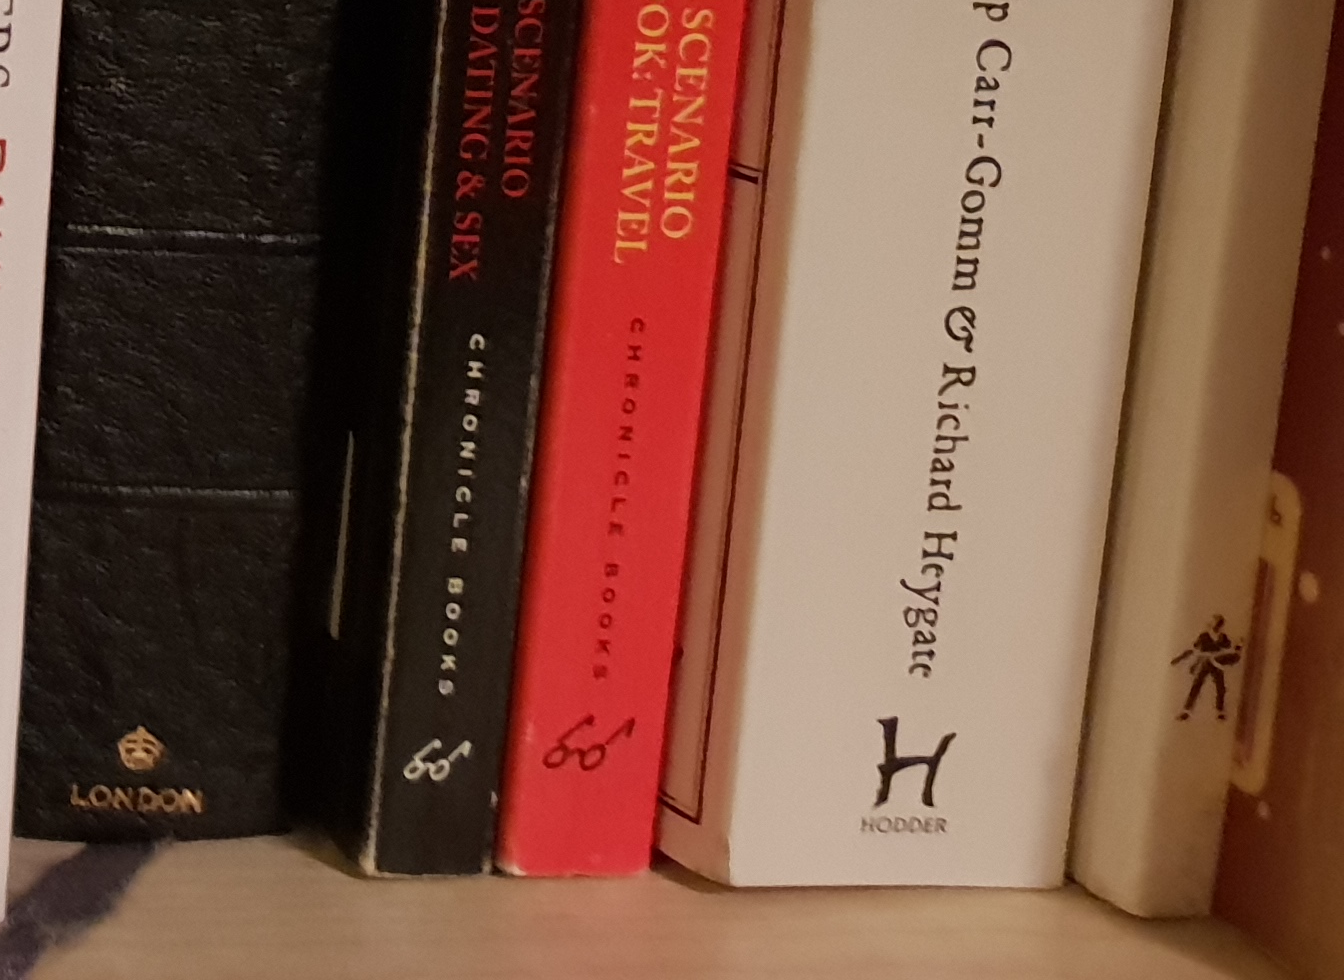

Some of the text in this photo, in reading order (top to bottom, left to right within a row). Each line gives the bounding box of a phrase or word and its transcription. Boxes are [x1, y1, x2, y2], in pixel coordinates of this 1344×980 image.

[457, 5, 504, 162] DATING
[657, 6, 715, 240] SCENARIO
[453, 168, 485, 202] &
[611, 89, 664, 266] TRAVEL
[948, 38, 1014, 294] Carr-Gomm
[445, 209, 484, 285] SEX
[944, 305, 978, 354] &
[591, 316, 648, 683] CHRONICLE BOOKS
[924, 362, 980, 513] Richard
[435, 332, 487, 698] CHRONICLE BOOKS
[898, 528, 960, 681] Heygate
[66, 783, 206, 812] LONDON
[859, 816, 947, 835] HODDER
